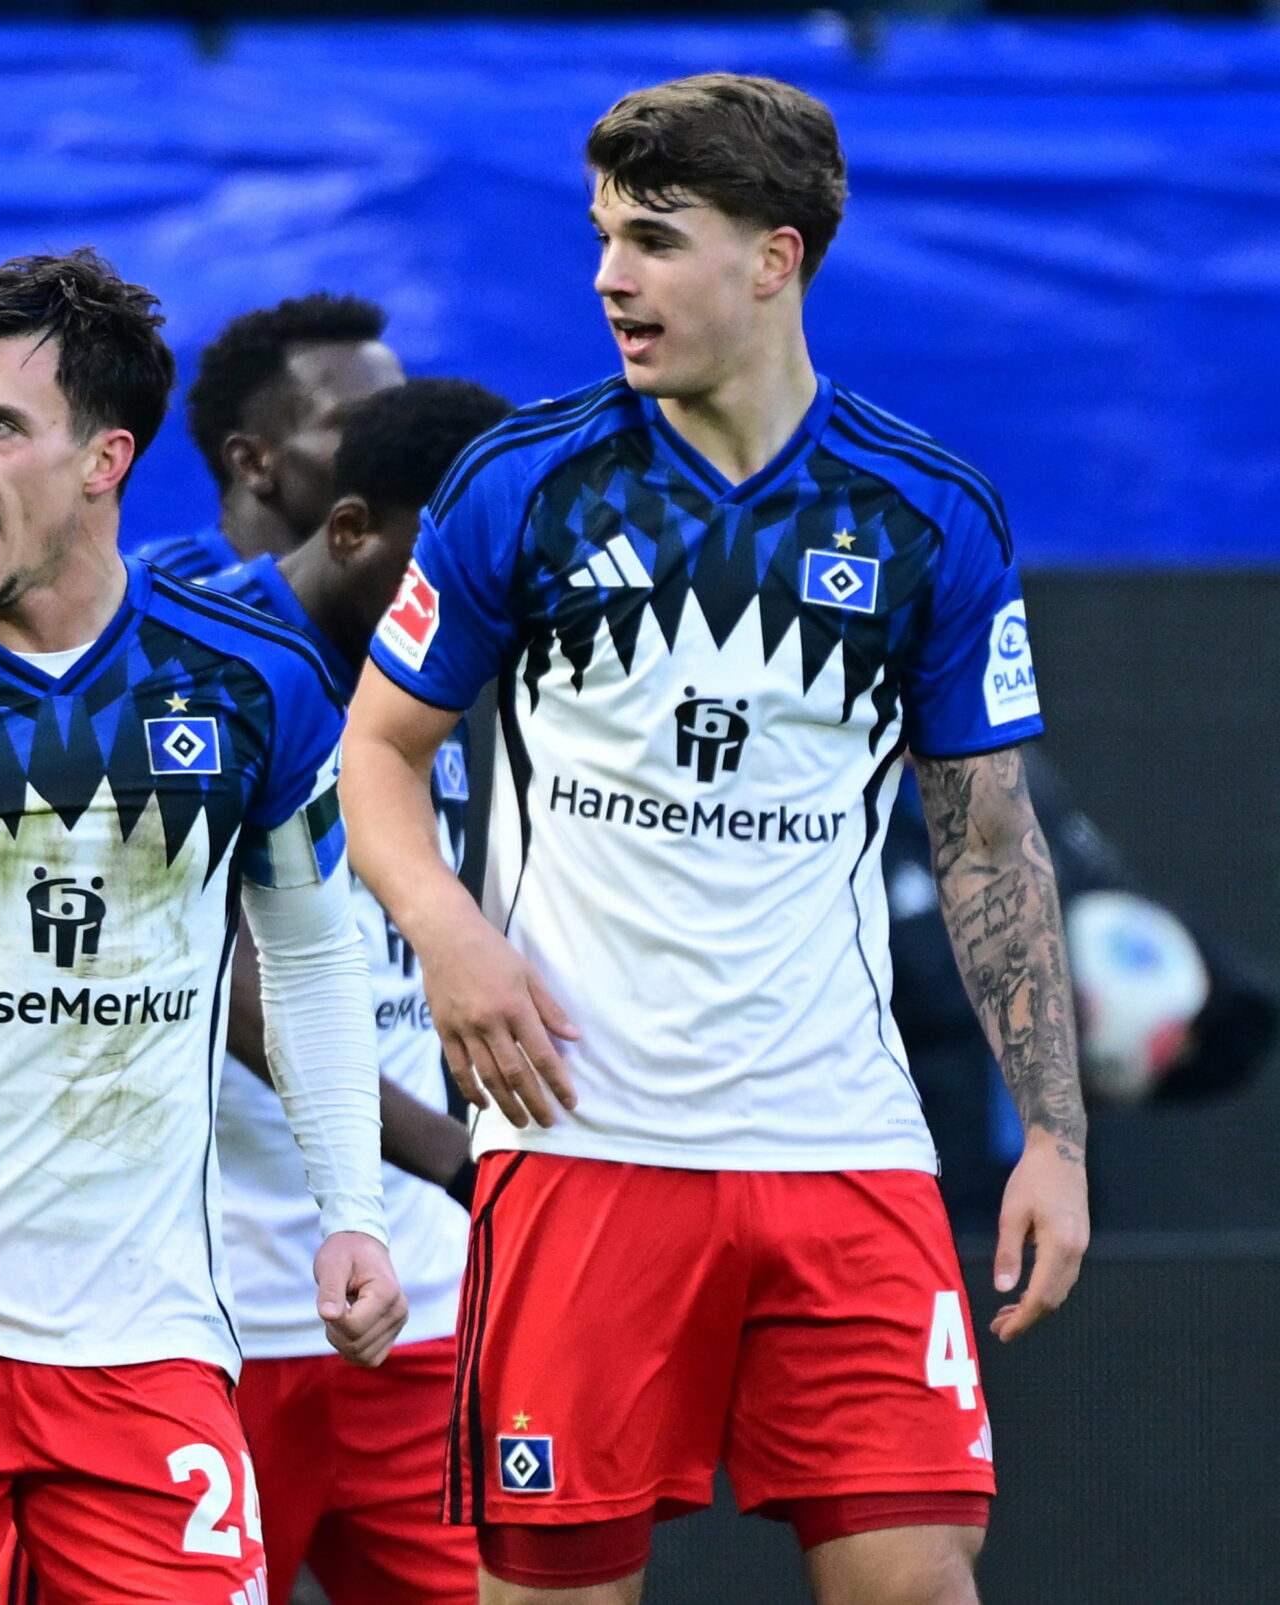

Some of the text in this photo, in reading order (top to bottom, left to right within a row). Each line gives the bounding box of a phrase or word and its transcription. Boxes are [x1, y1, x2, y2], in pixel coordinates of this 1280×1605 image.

[550, 776, 846, 843] HanseMerkur
[375, 994, 432, 1030] eMe
[926, 1290, 978, 1410] 4
